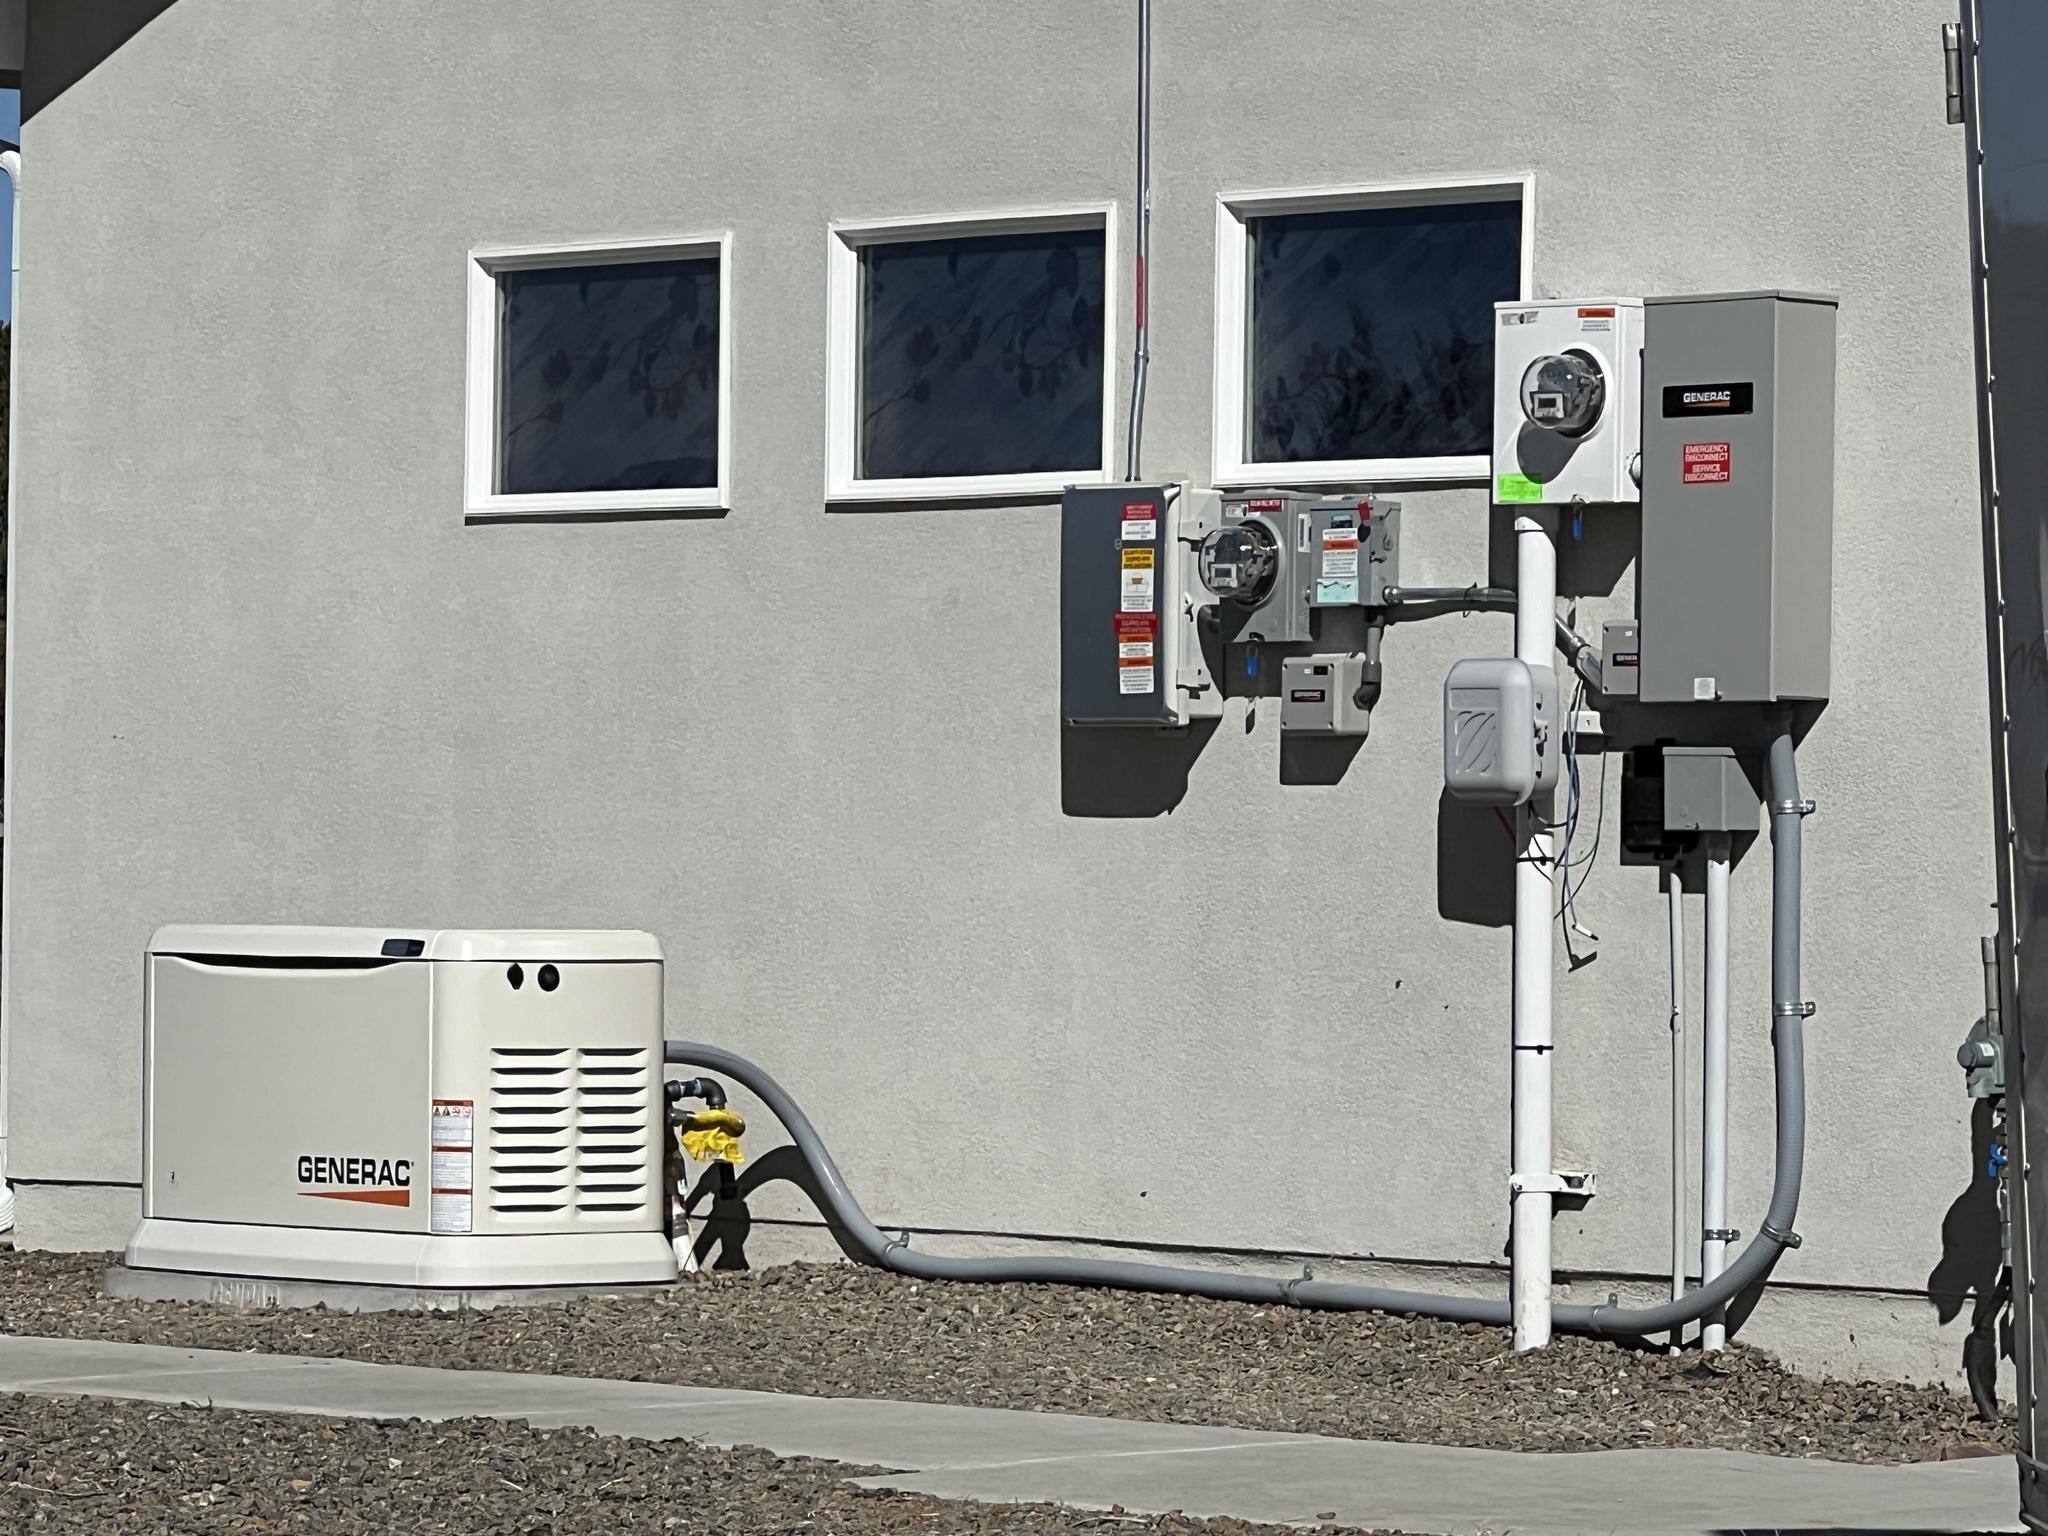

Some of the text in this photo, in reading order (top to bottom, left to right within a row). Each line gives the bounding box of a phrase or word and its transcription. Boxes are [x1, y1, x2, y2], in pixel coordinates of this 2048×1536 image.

[1683, 391, 1731, 403] GENERAC
[1685, 445, 1728, 454] EMERGENCY
[1684, 453, 1728, 462] DISCONNECT
[1684, 472, 1728, 481] DISCONNECT
[298, 1156, 410, 1186] GENERAC
